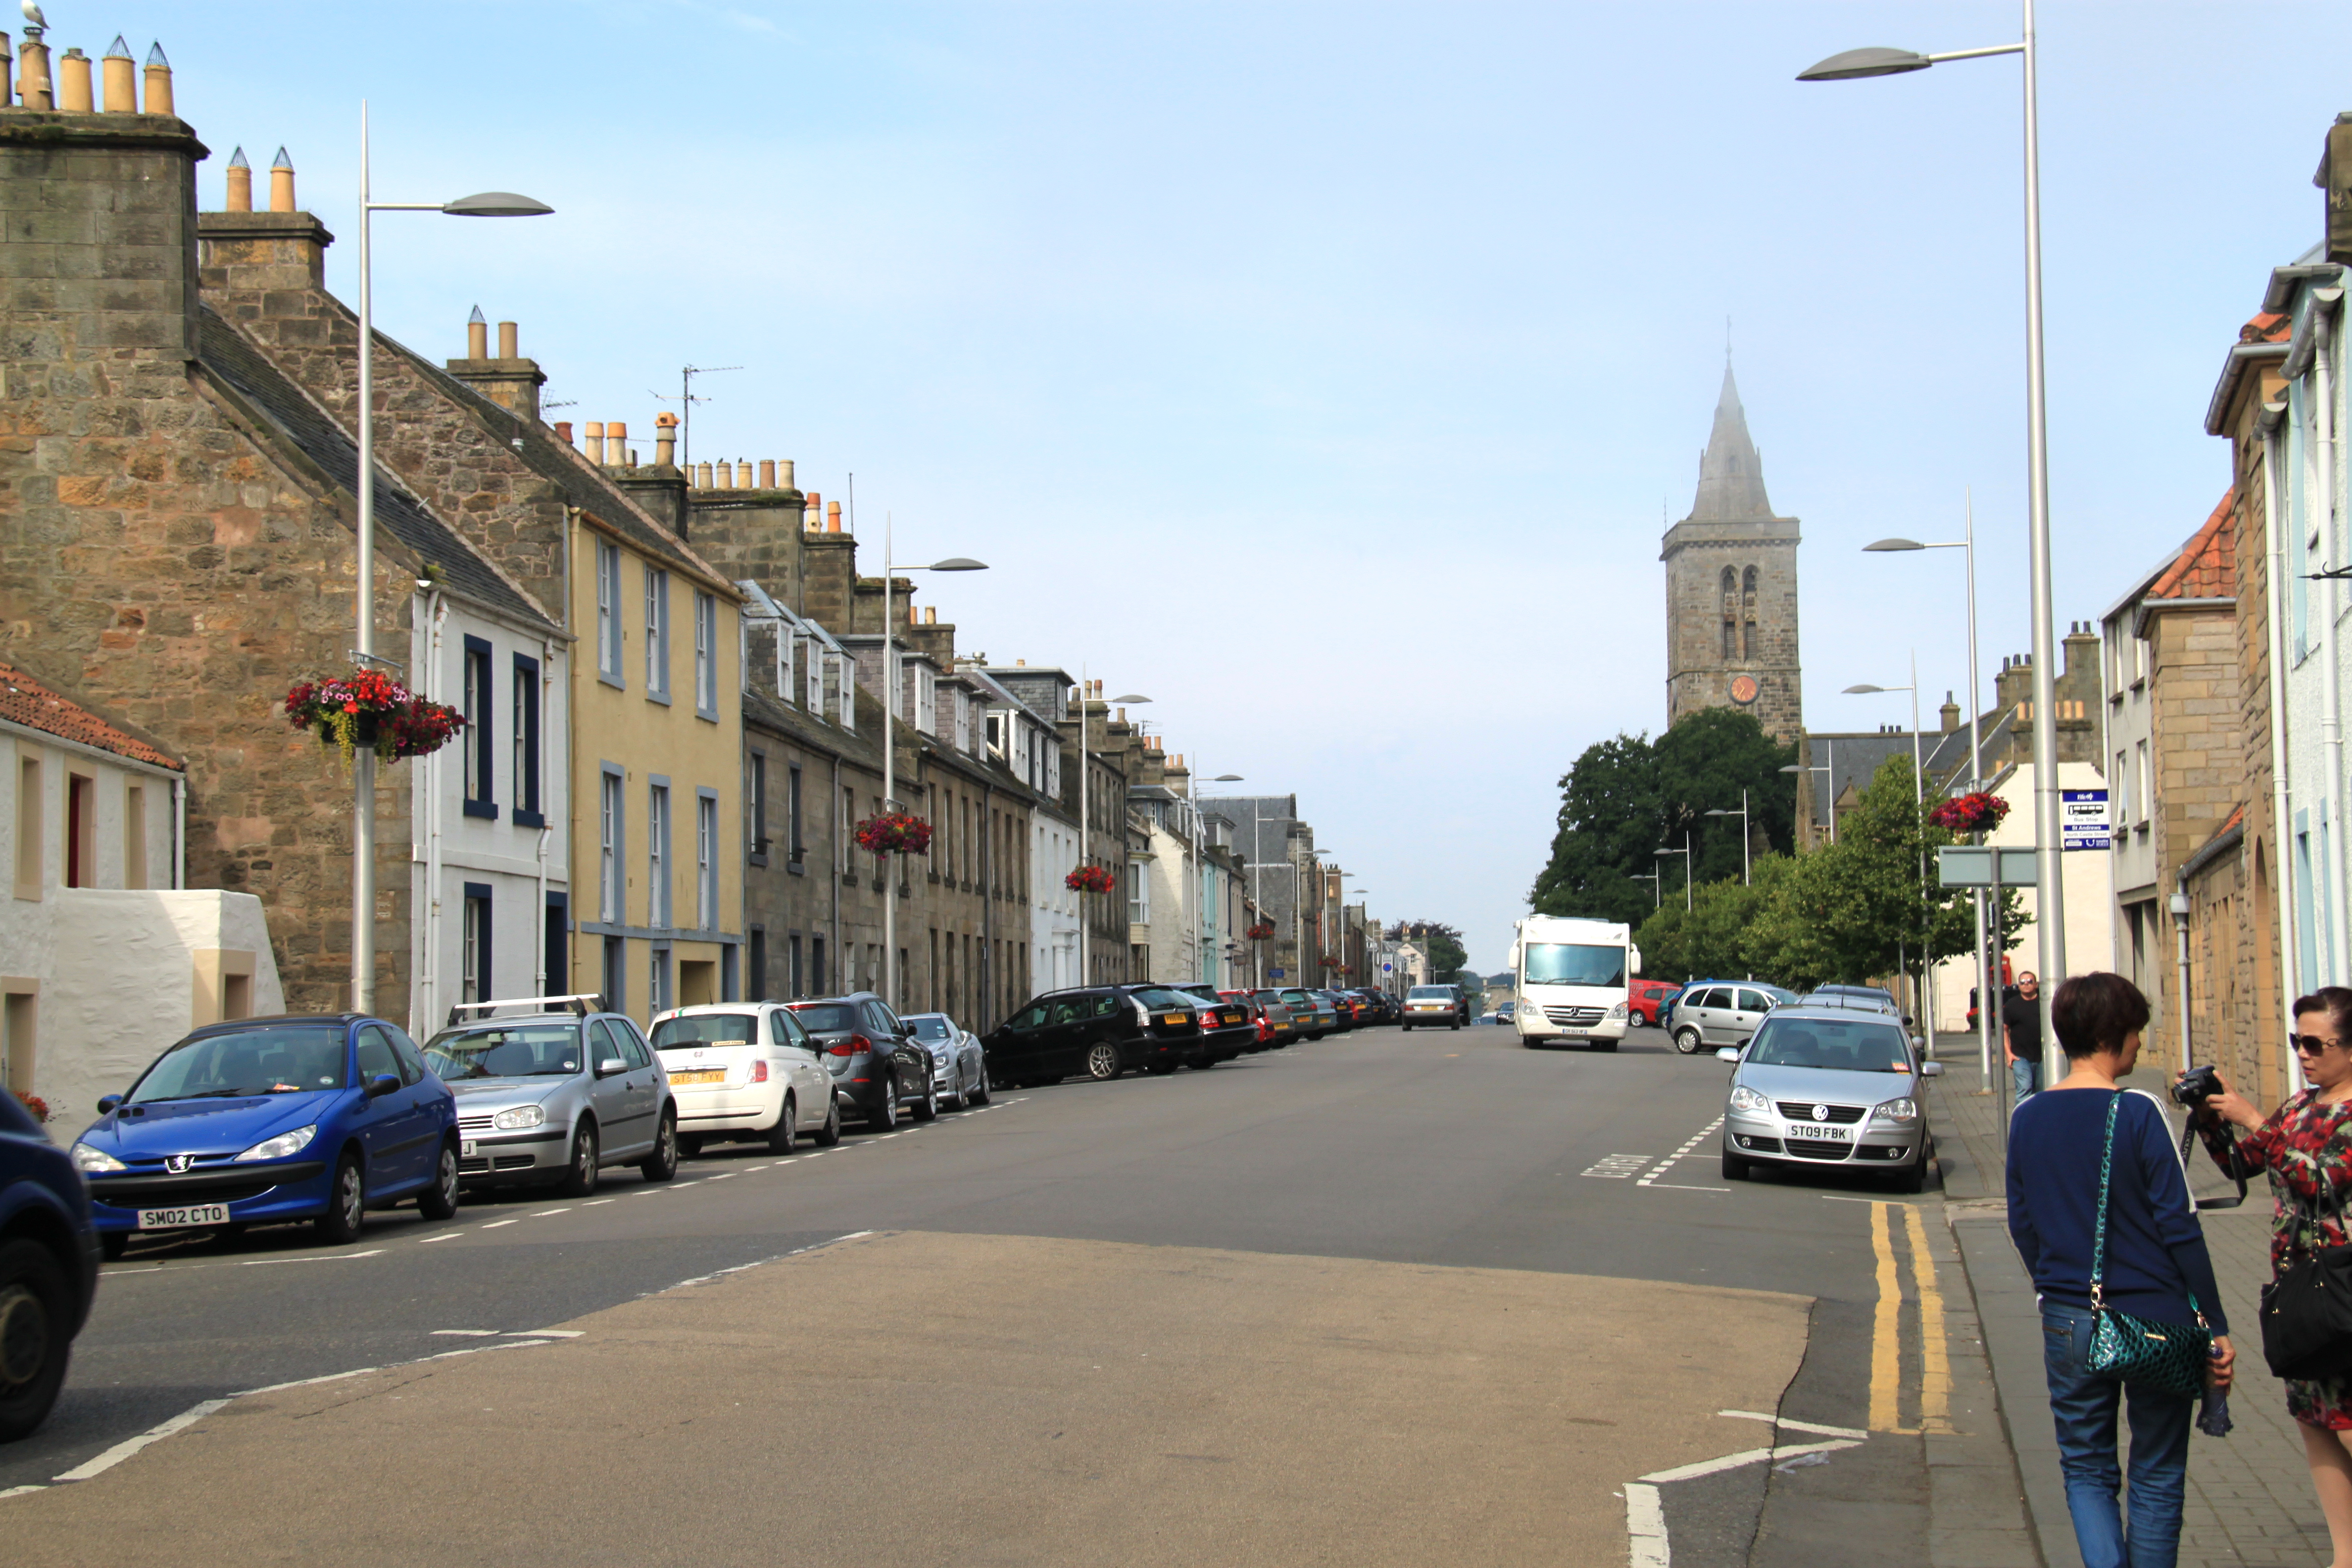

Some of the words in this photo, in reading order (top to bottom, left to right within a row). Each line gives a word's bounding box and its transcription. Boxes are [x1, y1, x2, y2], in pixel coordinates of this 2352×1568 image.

[675, 1073, 698, 1083] ST58
[701, 1072, 720, 1081] FYY
[1791, 1126, 1820, 1137] ST09
[1824, 1128, 1846, 1139] FBK
[146, 1210, 187, 1225] SM02
[191, 1207, 222, 1222] CTO
